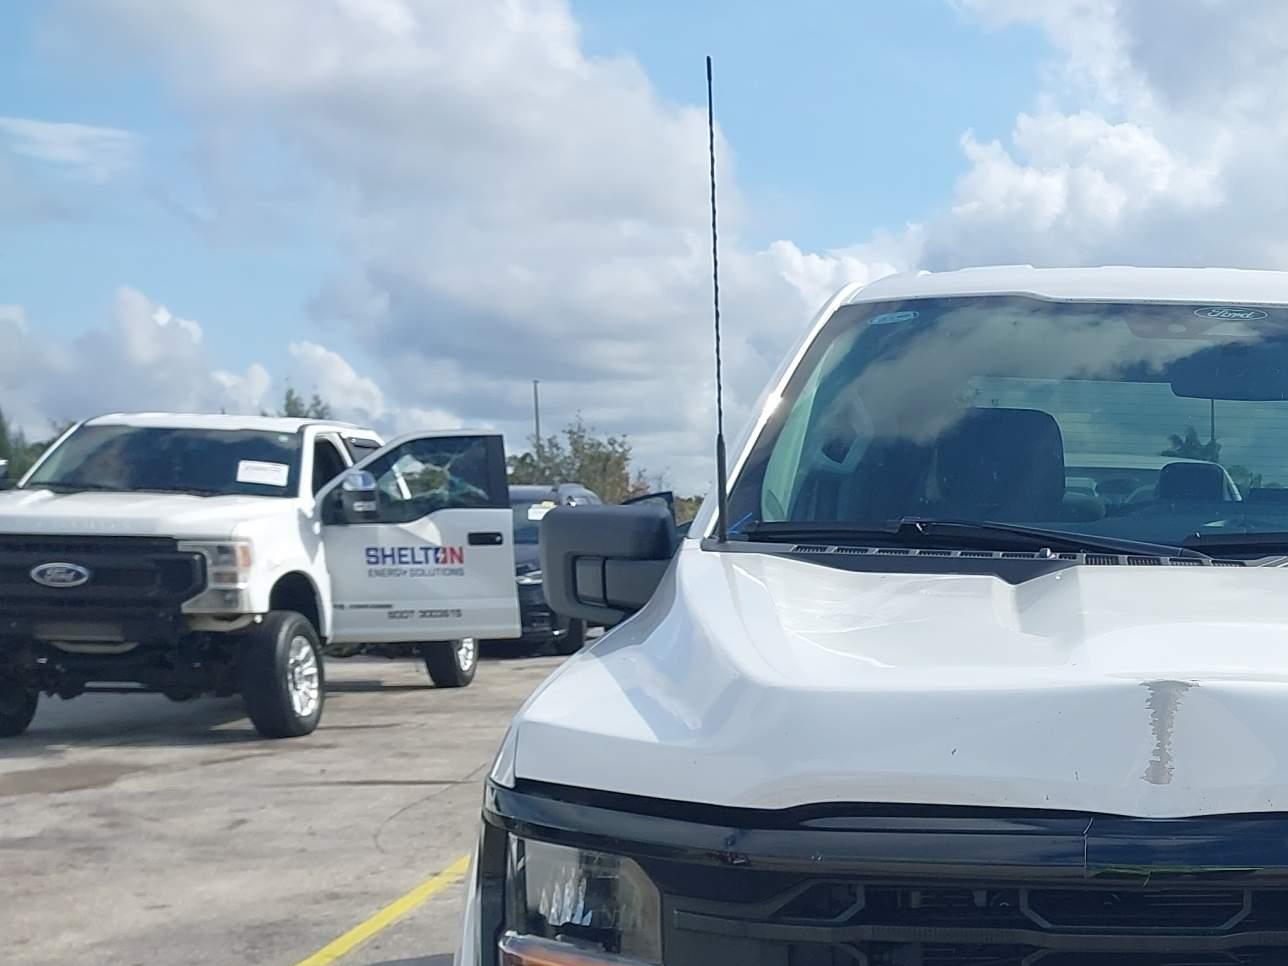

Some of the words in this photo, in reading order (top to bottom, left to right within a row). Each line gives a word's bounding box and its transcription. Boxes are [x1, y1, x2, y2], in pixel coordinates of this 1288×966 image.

[1207, 308, 1255, 319] Ford
[365, 546, 465, 566] SHELTON
[409, 568, 465, 577] SOLUTIONS
